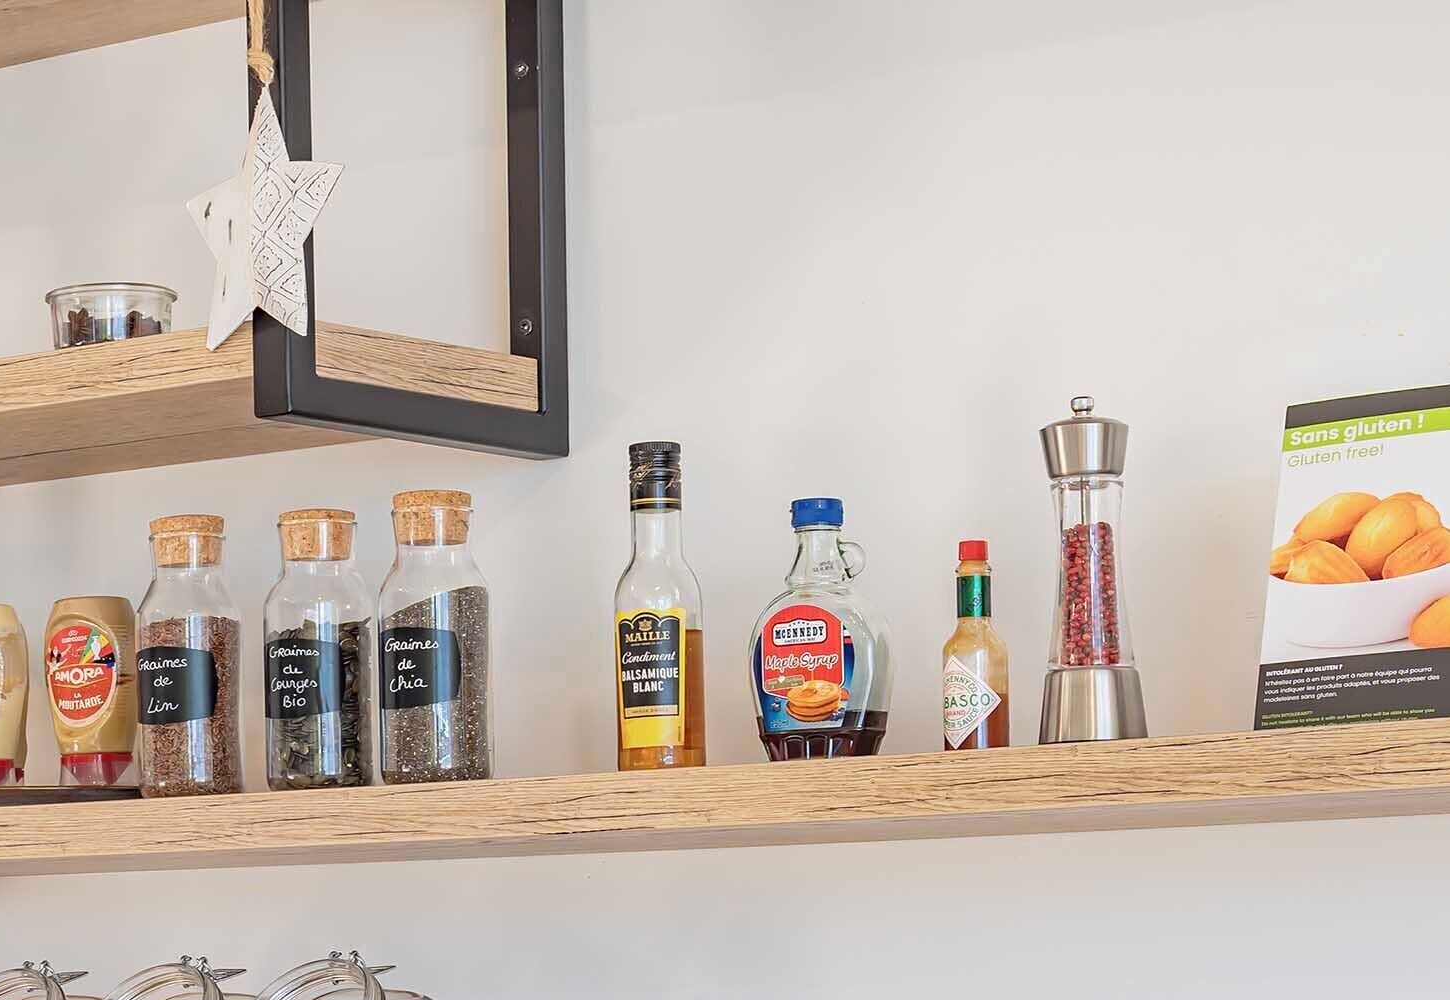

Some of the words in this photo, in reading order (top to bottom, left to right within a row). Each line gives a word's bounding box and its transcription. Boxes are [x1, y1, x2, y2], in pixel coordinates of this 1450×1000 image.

[1290, 427, 1339, 446] Sans
[1343, 417, 1411, 442] gluten
[1287, 450, 1341, 468] Gluten
[1346, 444, 1384, 459] free!
[625, 630, 670, 643] MAILLE
[397, 658, 416, 670] de
[622, 650, 676, 665] Condiment
[765, 653, 799, 673] Maple
[800, 652, 839, 671] Syrup
[54, 667, 104, 684] AMORA
[282, 664, 303, 674] de
[622, 667, 679, 682] BALSAMIQUE
[1314, 665, 1338, 673] GLUTEN
[1410, 667, 1432, 675] pourra
[153, 675, 173, 687] de
[270, 677, 318, 693] Courges
[390, 674, 429, 693] Chia
[633, 680, 665, 693] BLANC
[1397, 676, 1426, 684] proposer
[58, 695, 104, 710] MOUTARDE
[147, 697, 179, 713] Lin
[944, 692, 990, 709] BASCO
